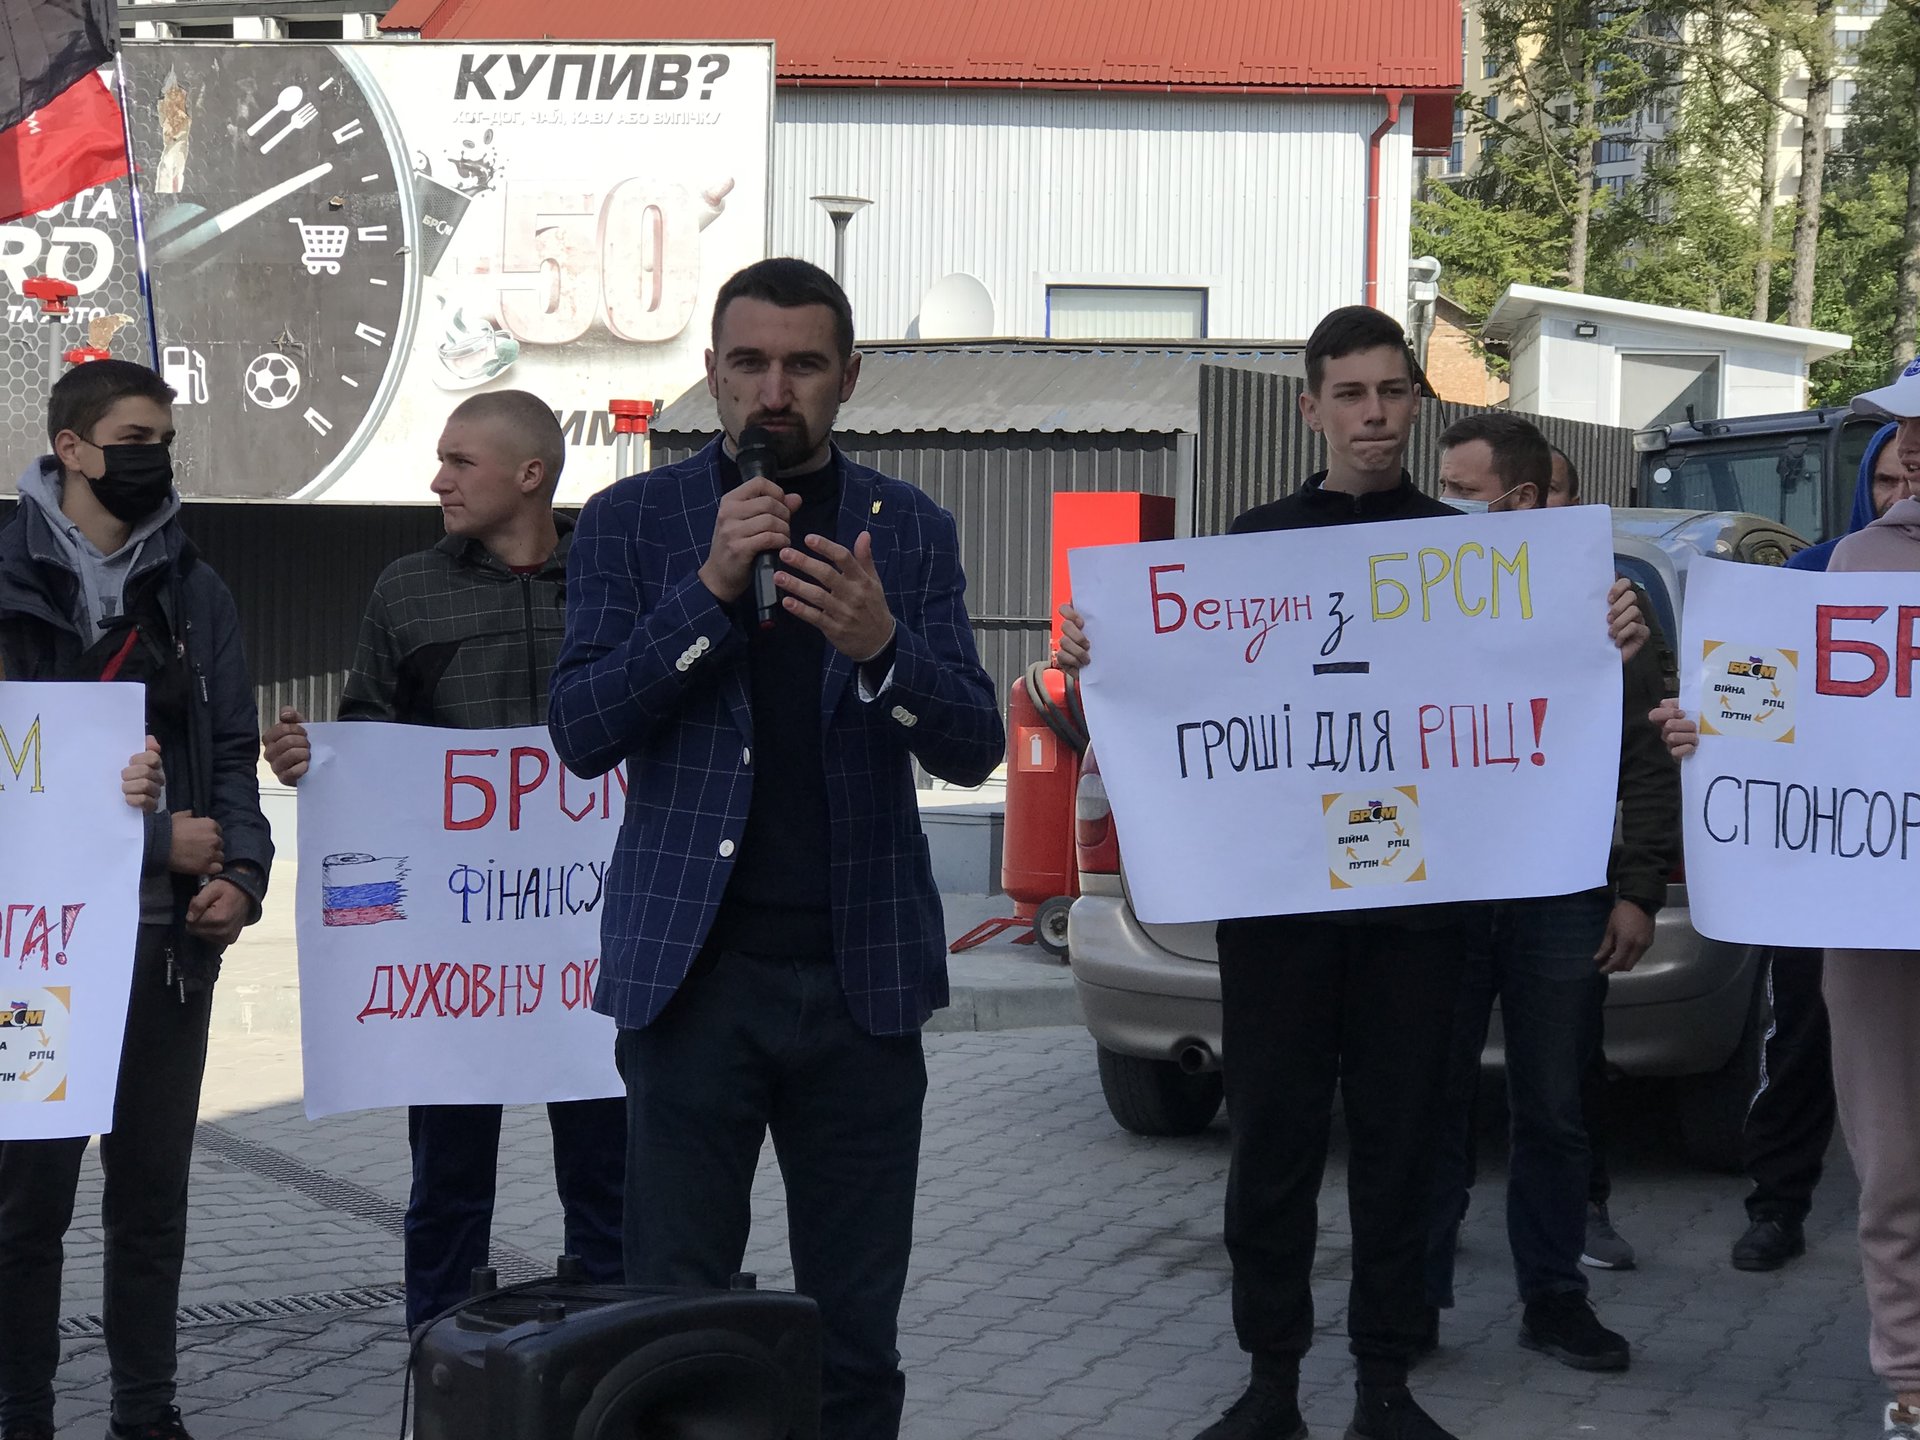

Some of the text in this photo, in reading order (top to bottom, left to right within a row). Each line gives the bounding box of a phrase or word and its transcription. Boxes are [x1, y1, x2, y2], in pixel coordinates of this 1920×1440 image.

[453, 53, 731, 100] КУПИВ?
[7, 305, 34, 323] ТА
[1368, 541, 1533, 623] БРСМ
[1727, 661, 1778, 680] БРСМ
[1714, 684, 1746, 695] ВІЙНА
[1762, 698, 1785, 709] РПЦ
[1720, 710, 1752, 721] ПУТІН
[1176, 698, 1549, 780] ГРОШІ ДЛЯ РПЦ!
[1349, 806, 1398, 825] БРСМ
[1338, 834, 1370, 845] ВІЙНА
[1387, 839, 1410, 848] РПЦ
[1349, 859, 1379, 870] ПУТІН
[448, 859, 612, 923] ФІНАНСУ
[0, 902, 86, 971] ГА!
[356, 962, 546, 1025] ДУХОВНУ
[28, 1050, 56, 1061] РПЦ
